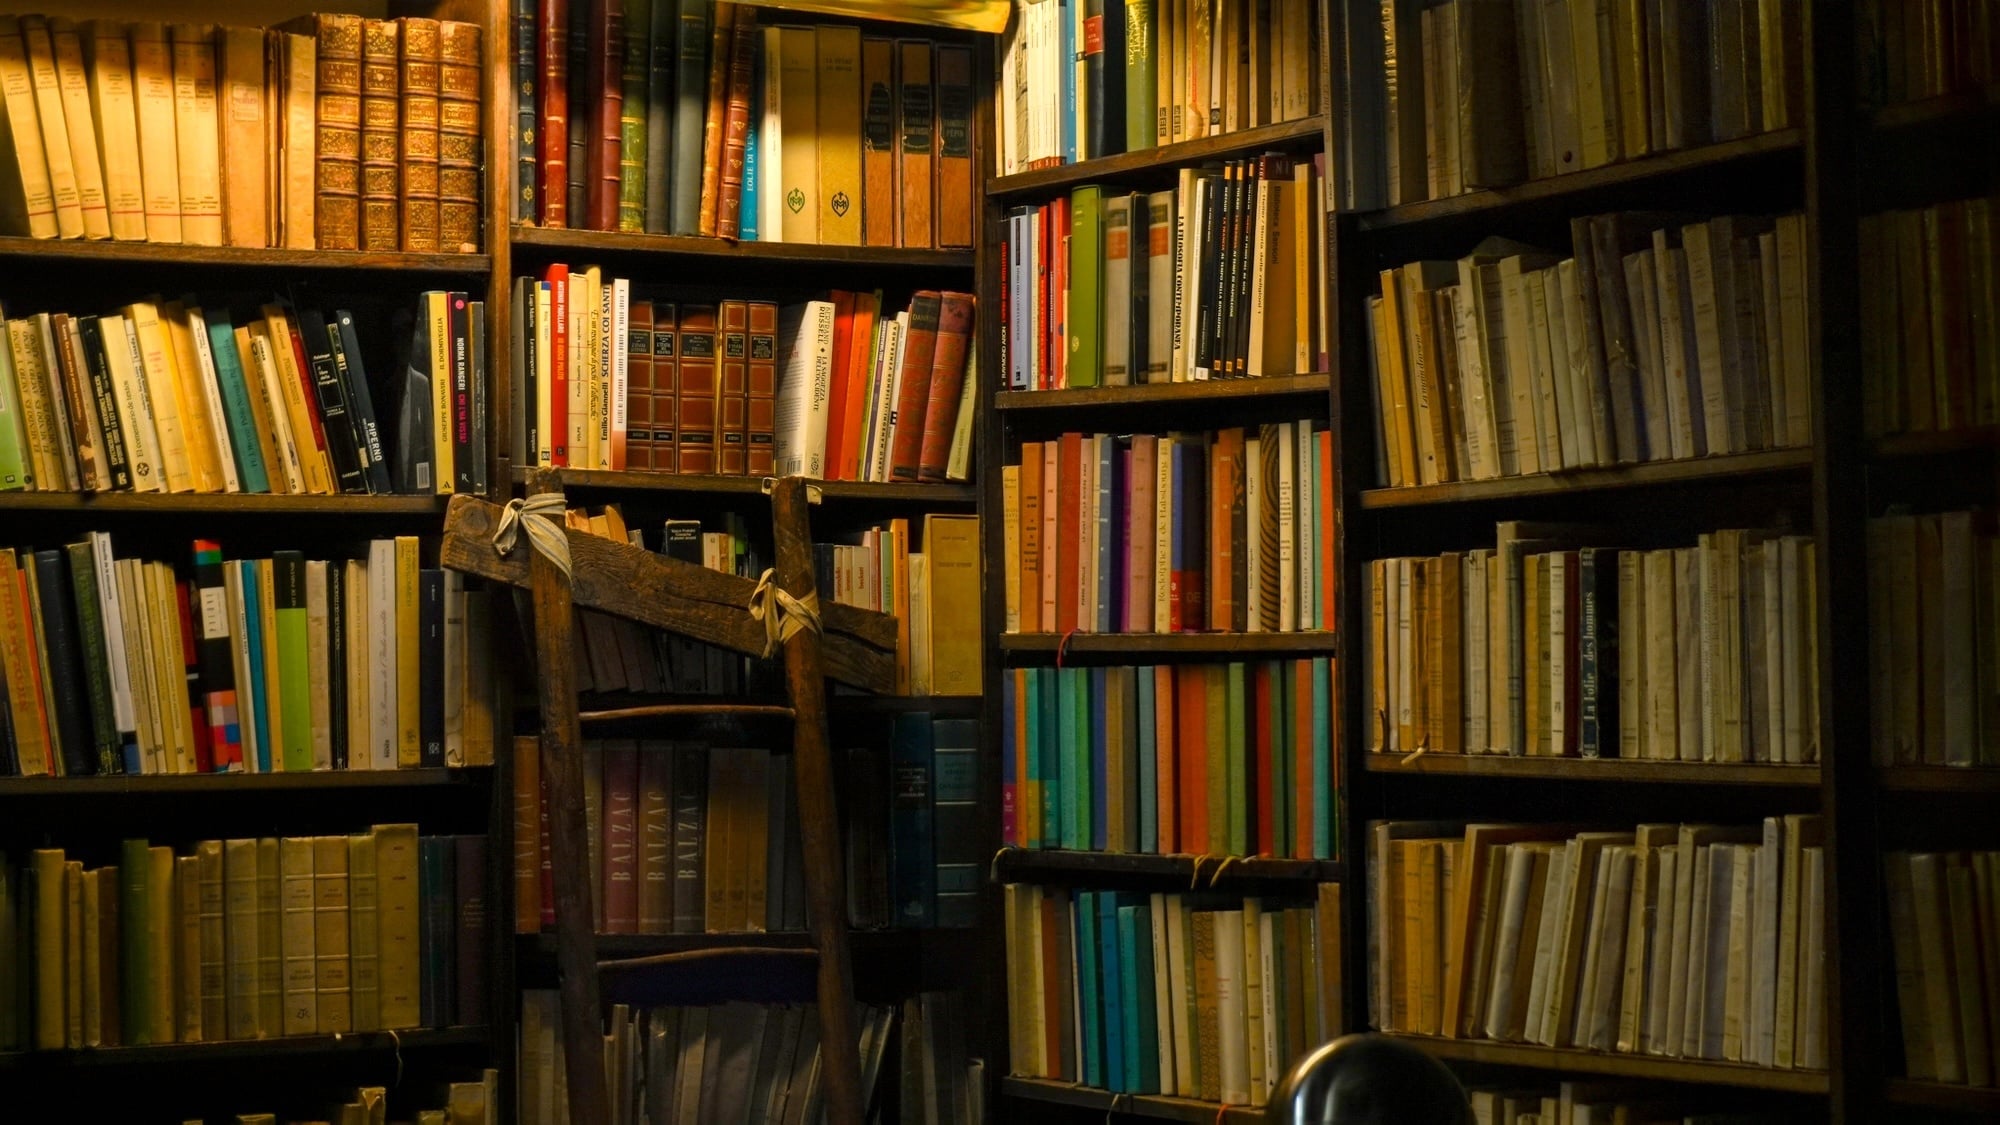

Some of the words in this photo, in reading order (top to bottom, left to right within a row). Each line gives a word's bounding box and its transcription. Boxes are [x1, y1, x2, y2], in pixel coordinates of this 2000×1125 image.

[747, 154, 755, 164] DI
[746, 166, 755, 192] EOLIE
[1177, 216, 1184, 226] LA
[1272, 186, 1281, 227] Biblioteca
[1272, 231, 1281, 265] Sansoni
[557, 281, 565, 304] ANTONIO
[602, 286, 611, 314] SANTI
[557, 304, 565, 334] PADELLARO
[602, 316, 610, 333] COI
[817, 306, 825, 344] RUSSELL
[1175, 275, 1183, 350] CONTEMPORANEA
[457, 338, 465, 361] NORMA
[602, 335, 610, 377] SCHERZA
[123, 380, 133, 400] textos
[457, 362, 465, 390] RANGERI
[819, 366, 828, 402] SAGGEZZA
[127, 401, 135, 409] de
[601, 382, 609, 416] Giannelli
[129, 410, 142, 448] comentario
[366, 422, 382, 462] PIPERNO
[601, 416, 609, 440] Emilio
[1159, 461, 1168, 518] Habsbourg
[1158, 522, 1167, 535] de
[1158, 550, 1167, 602] Rodolphe
[1582, 592, 1595, 639] hommes
[1583, 642, 1595, 661] des
[1583, 673, 1595, 701] Folie
[1583, 705, 1595, 720] La
[612, 792, 632, 880] BALZAC
[648, 792, 666, 880] BALZAC
[678, 792, 698, 878] BALZAC
